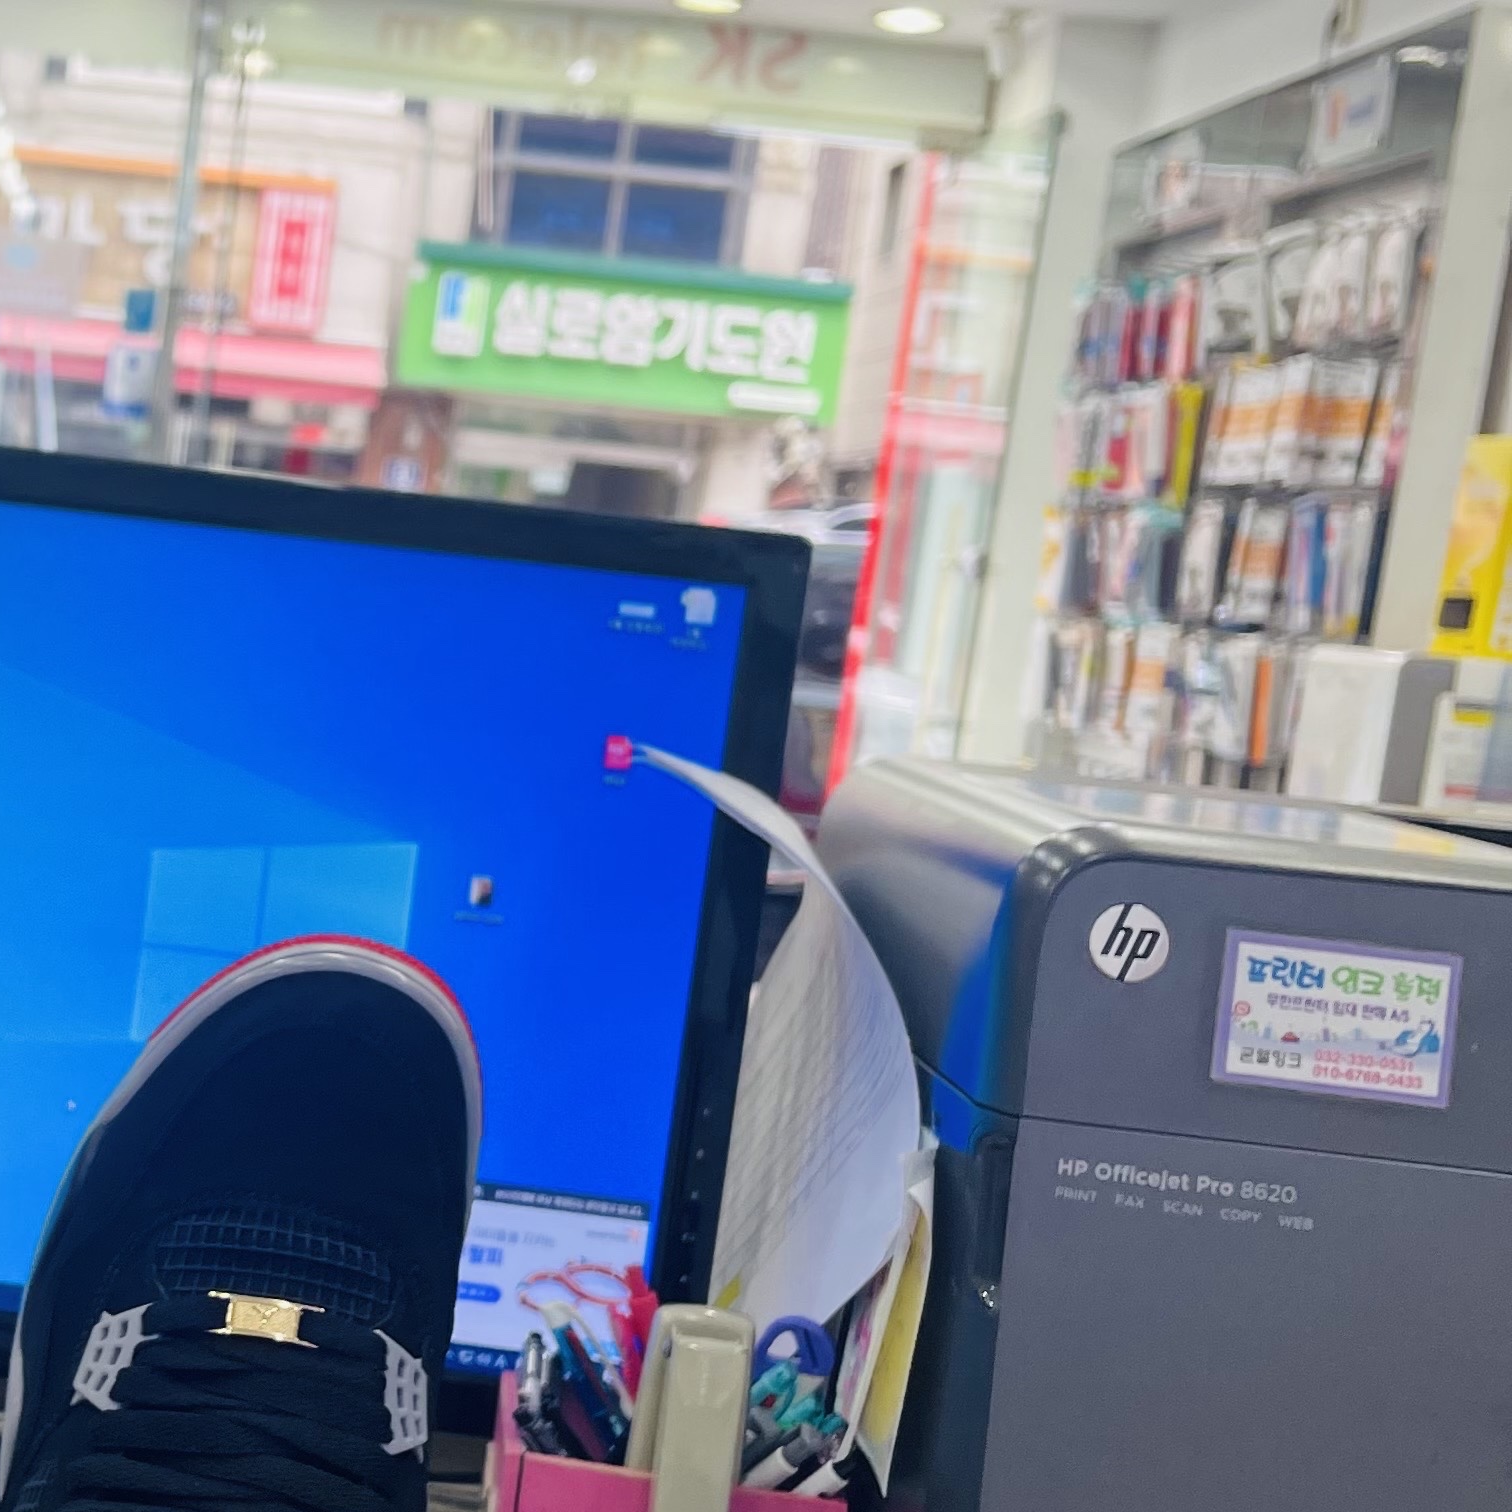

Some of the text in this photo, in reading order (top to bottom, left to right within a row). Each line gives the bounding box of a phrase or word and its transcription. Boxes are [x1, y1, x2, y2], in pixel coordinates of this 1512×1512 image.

[493, 280, 817, 384] 실로암기도원
[1100, 903, 1161, 981] hp
[1247, 955, 1326, 989] 프린터
[1331, 964, 1385, 996] 잉크
[1332, 1001, 1358, 1018] 임대
[1361, 1004, 1387, 1021] 판매
[1390, 1007, 1410, 1023] A/S
[1057, 1157, 1089, 1177] HP
[1196, 1175, 1234, 1197] Pro
[1239, 1180, 1298, 1204] 8620
[1054, 1185, 1315, 1231] PRINT FAX SCAN COPY WEB
